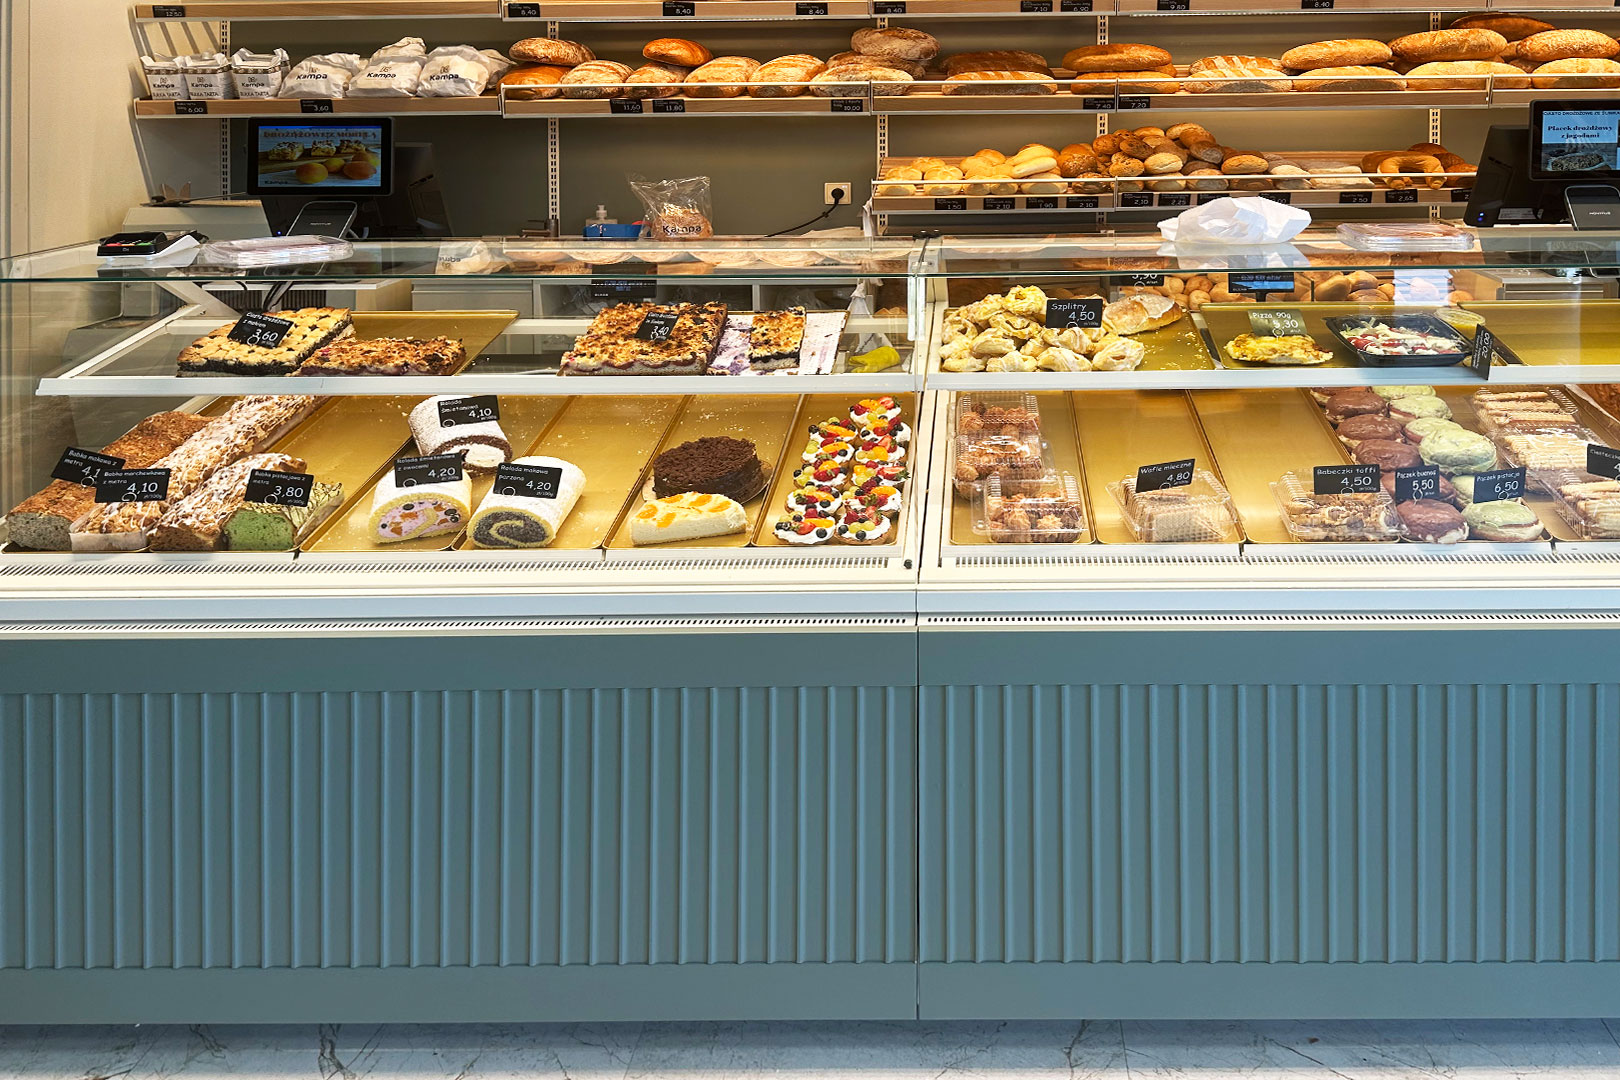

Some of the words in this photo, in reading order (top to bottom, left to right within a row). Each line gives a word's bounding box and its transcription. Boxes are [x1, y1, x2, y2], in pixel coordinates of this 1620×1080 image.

[296, 72, 328, 80] Kampa
[366, 72, 396, 80] Kampa
[430, 73, 460, 82] Kampa
[1566, 132, 1600, 140] jagodami
[1051, 302, 1087, 312] Szplitry
[1068, 311, 1096, 322] 4,50
[1276, 312, 1292, 320] 90g
[1272, 319, 1299, 329] 5,30
[252, 328, 279, 342] 3,60
[1481, 332, 1490, 359] 20,00
[468, 408, 493, 418] 4,10
[64, 458, 84, 467] metra
[68, 450, 88, 460] Babka
[88, 456, 112, 466] makowa
[82, 466, 102, 478] 4,1
[428, 467, 456, 478] 4,20
[1140, 466, 1162, 474] Wafle
[1163, 462, 1192, 471] mleczne
[1166, 471, 1190, 482] 4,80
[1396, 471, 1416, 479] Pączek
[1496, 472, 1520, 480] pistacja
[526, 480, 552, 491] 4,20
[1340, 476, 1372, 488] 4,50
[1412, 478, 1434, 491] 5,50
[1494, 480, 1519, 493] 6,50
[126, 482, 158, 494] 4,10
[274, 486, 304, 498] 3,80
